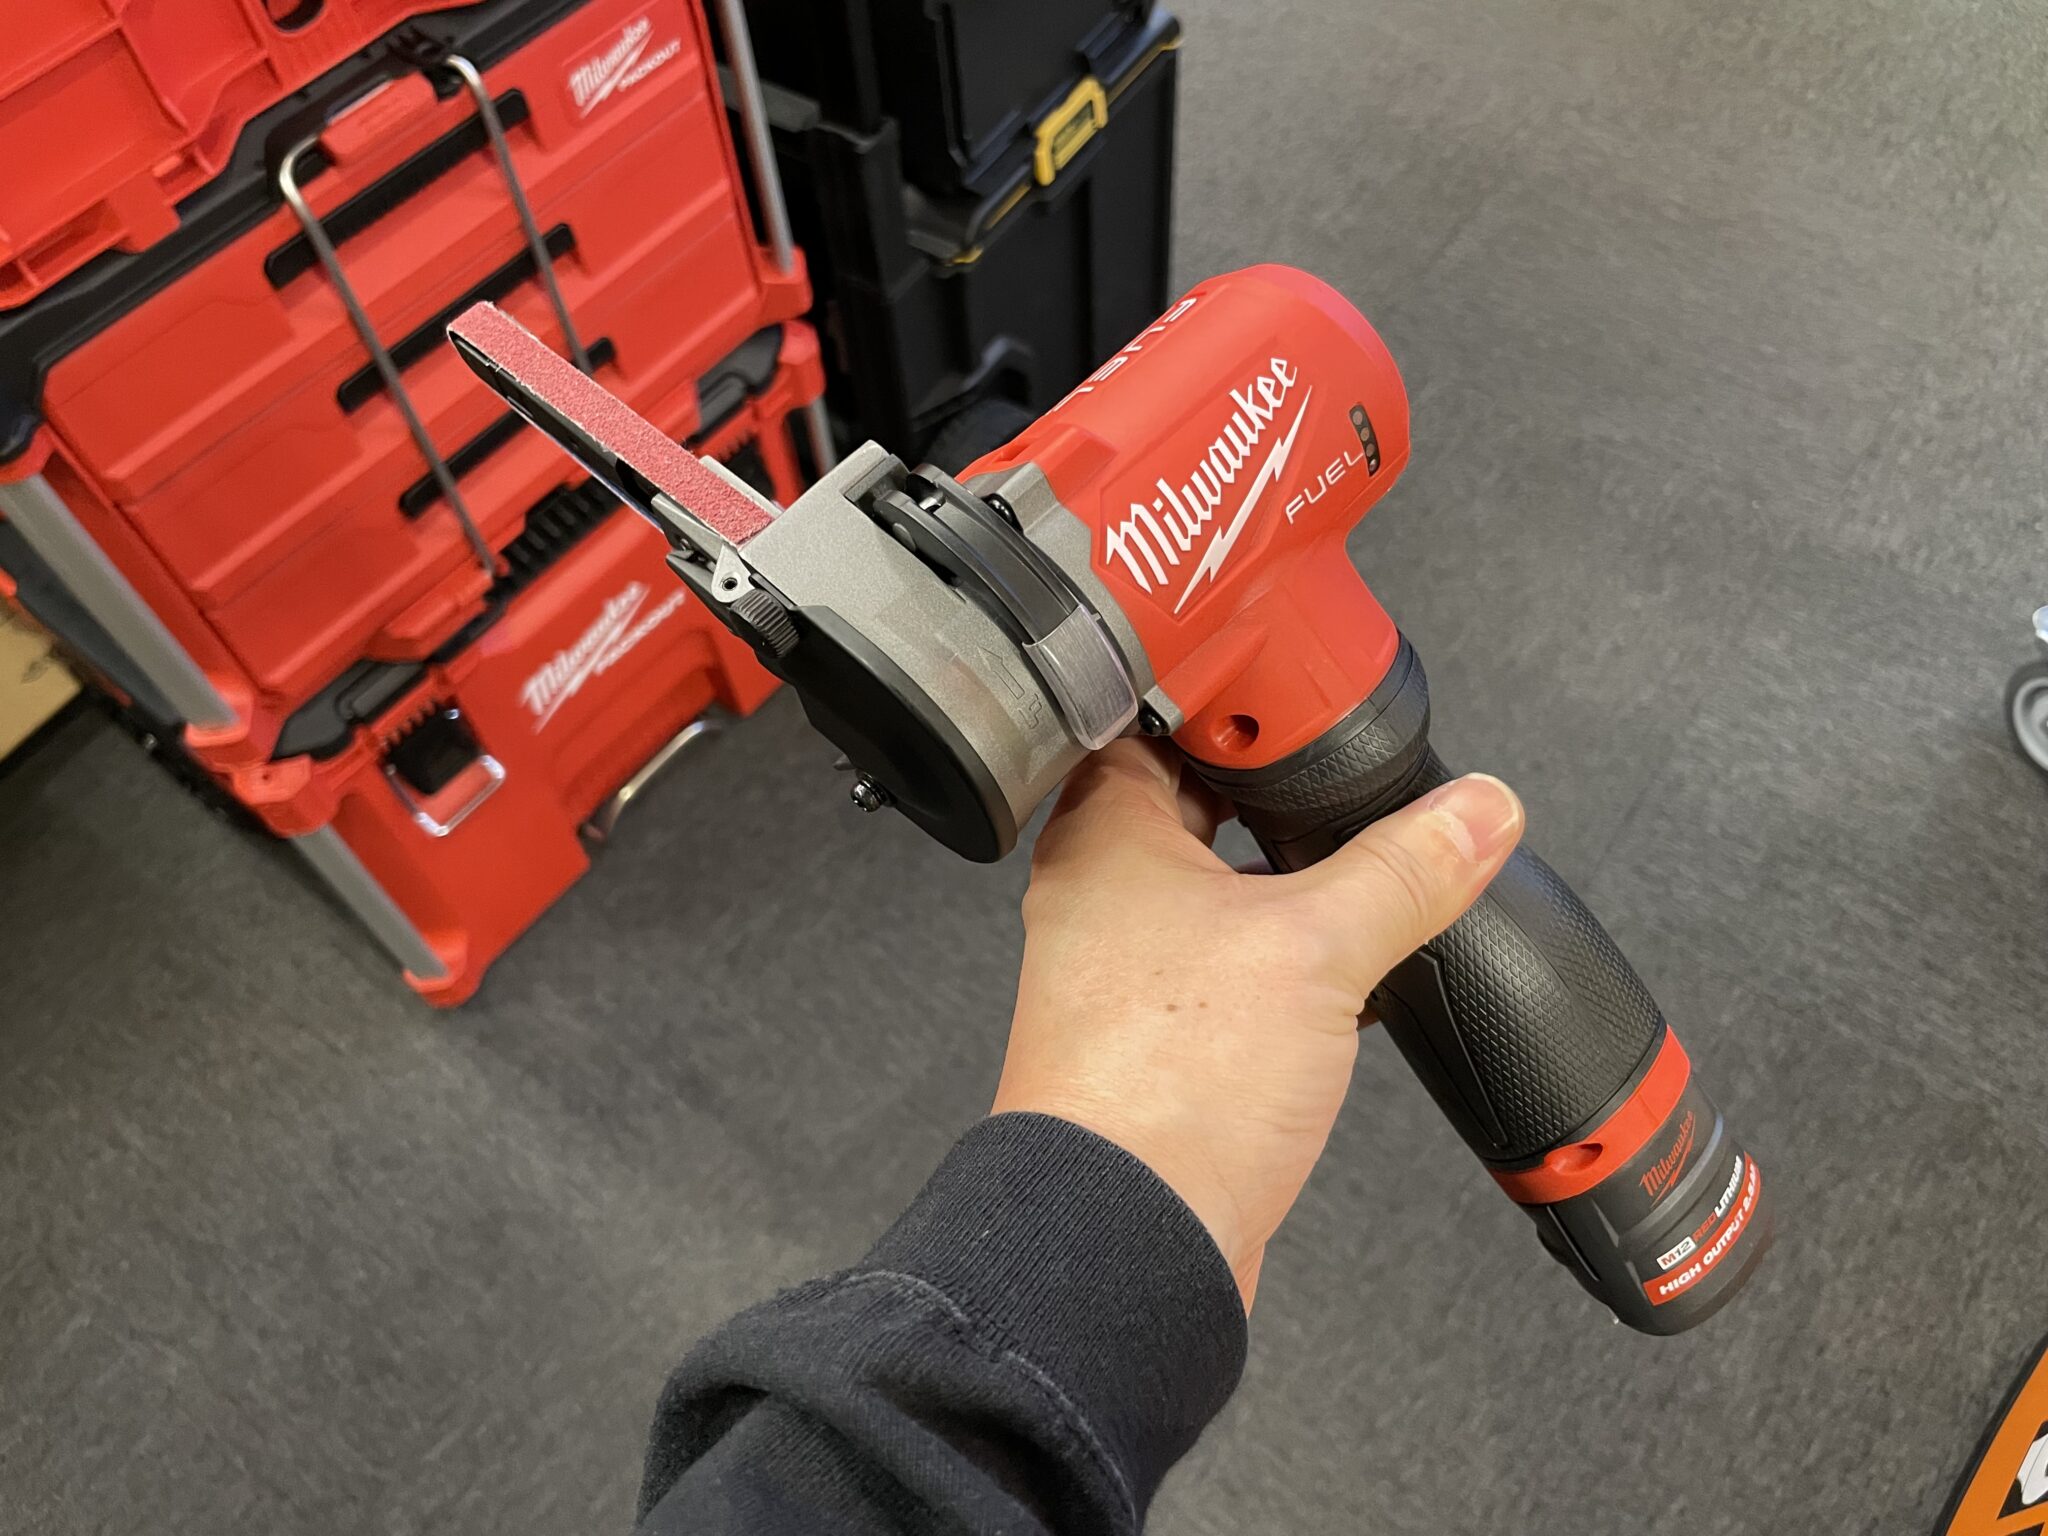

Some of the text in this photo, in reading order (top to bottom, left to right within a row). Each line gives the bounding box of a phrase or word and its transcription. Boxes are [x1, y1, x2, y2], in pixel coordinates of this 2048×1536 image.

[567, 15, 651, 107] Milwaukee
[1105, 357, 1298, 595] Milwaukee
[1284, 449, 1365, 525] FUEL
[519, 580, 643, 716] Milwaukee
[1658, 1262, 1702, 1296] HIGH
[1703, 1208, 1744, 1266] OUTPUT
[1660, 1240, 1692, 1267] M12
